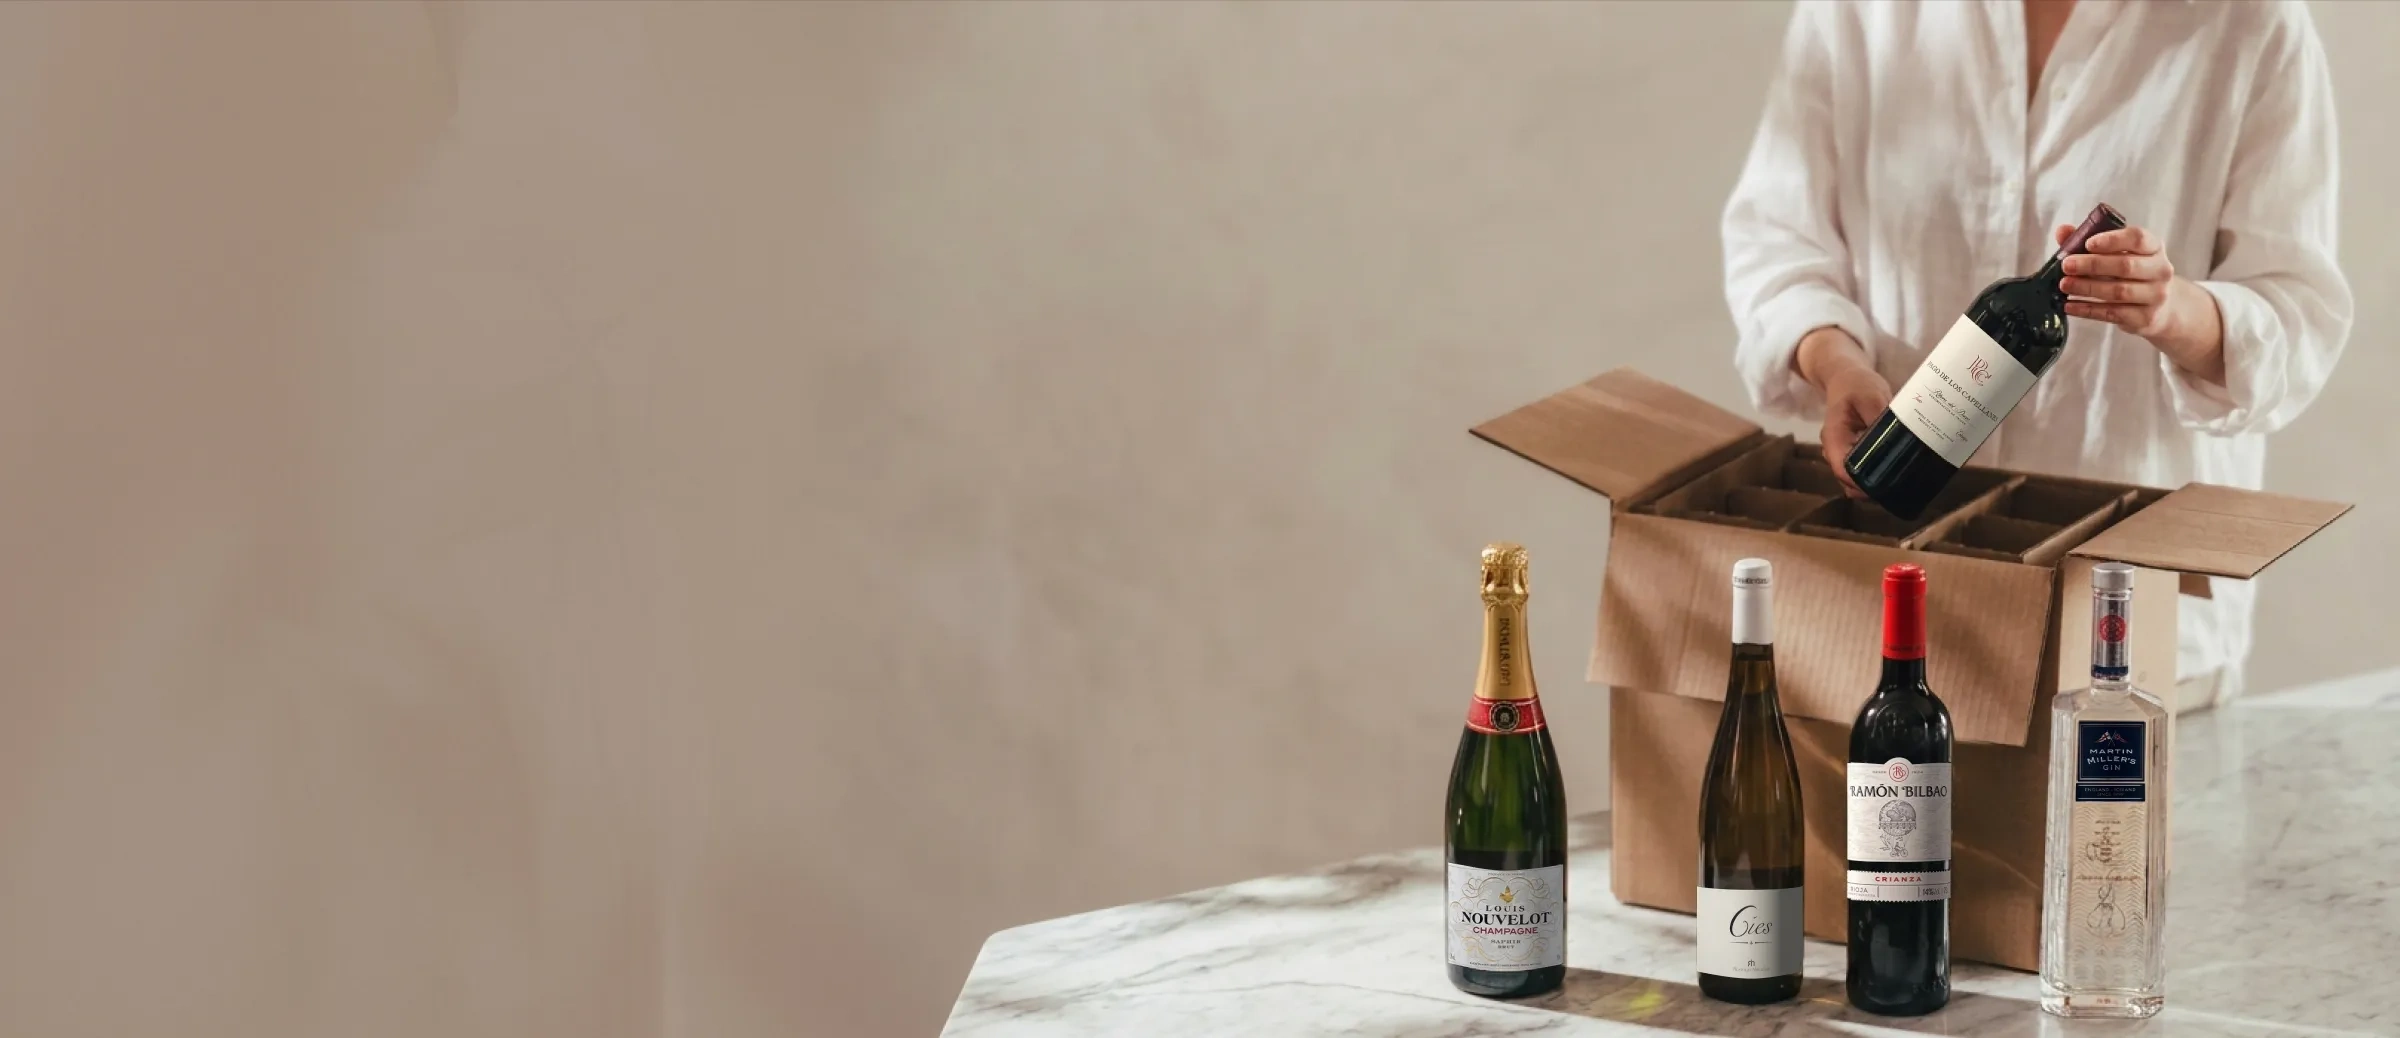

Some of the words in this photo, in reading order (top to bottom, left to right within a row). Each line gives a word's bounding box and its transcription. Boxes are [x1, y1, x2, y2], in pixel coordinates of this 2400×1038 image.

[1927, 361, 1941, 375] PAGO
[1940, 372, 1950, 382] DE
[1948, 379, 1962, 392] LOS
[2086, 756, 2136, 765] MILLER'S
[1850, 784, 1898, 797] RAMÓN
[1901, 785, 1947, 797] BILBAO
[1486, 904, 1525, 912] LOUIS
[1461, 911, 1550, 925] NOUVELOT
[1729, 905, 1772, 937] Cies
[1472, 926, 1538, 935] CHAMPAGNE
